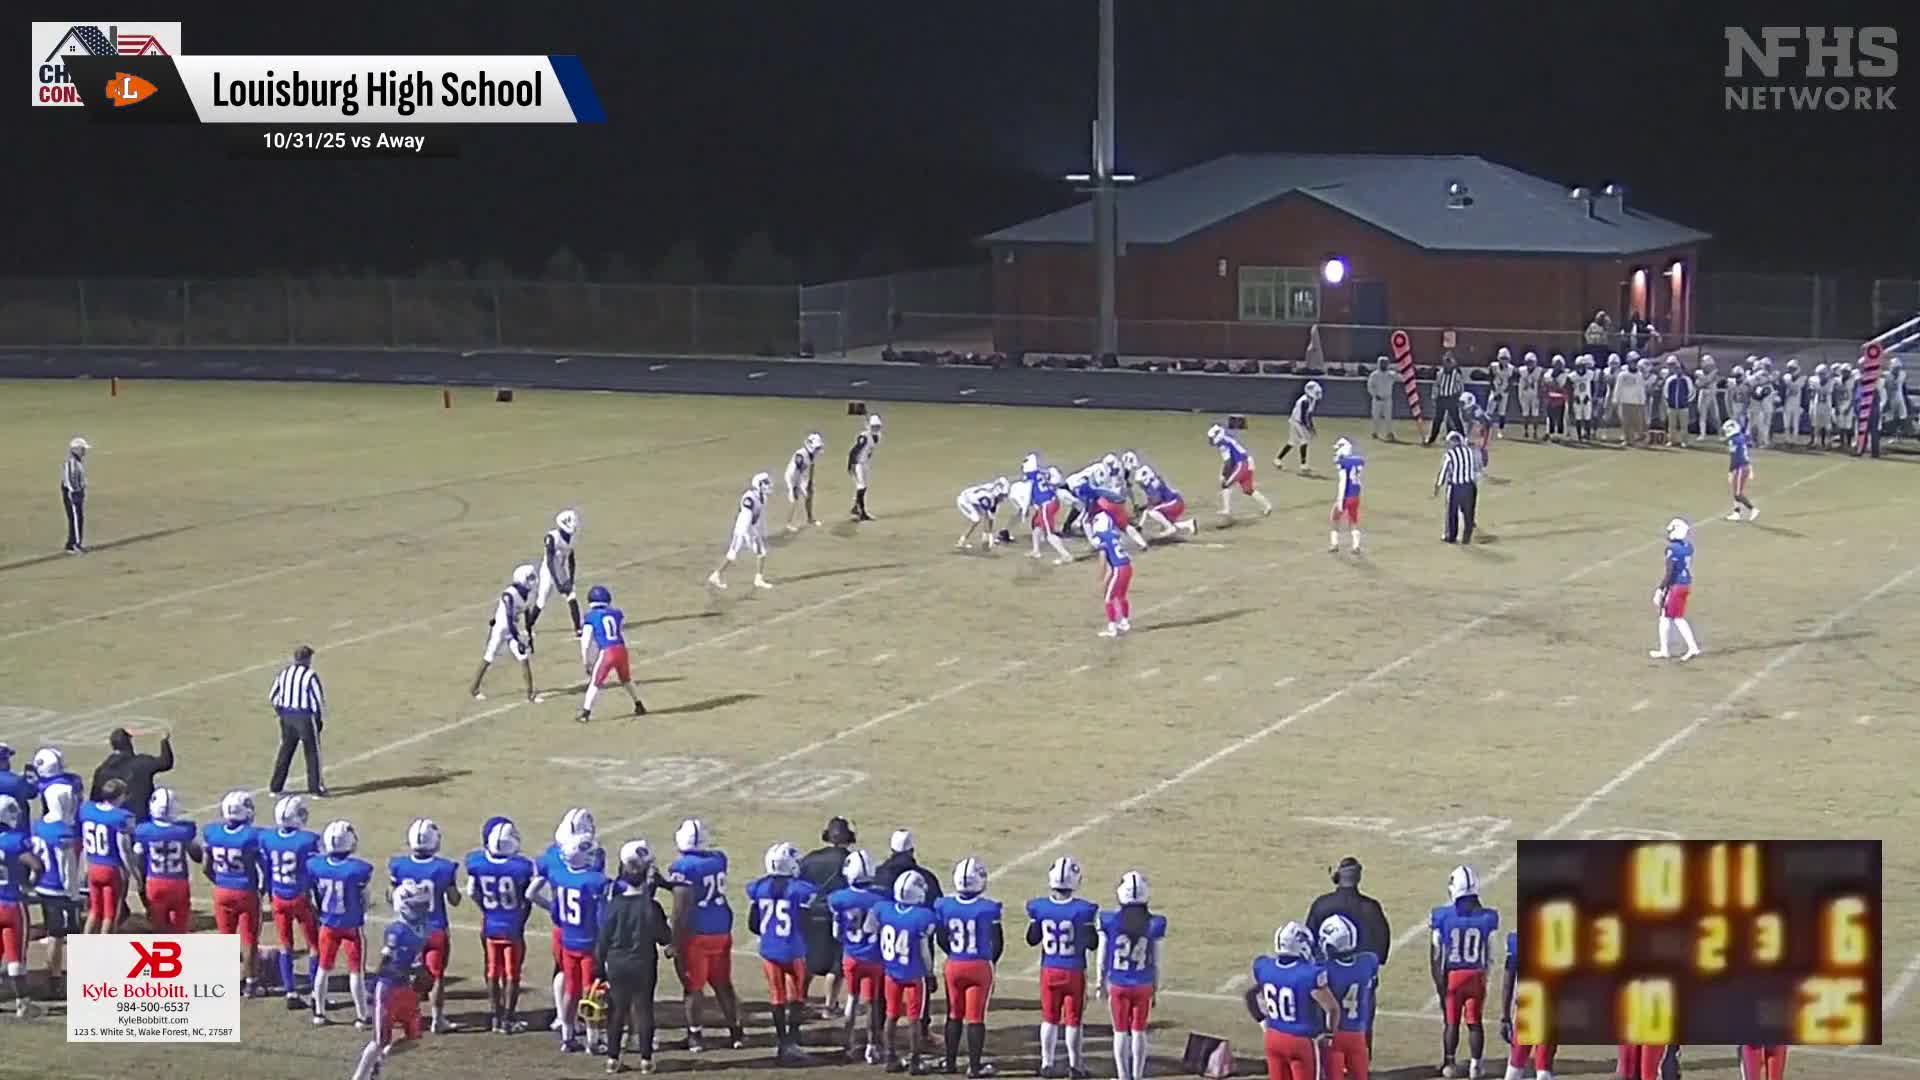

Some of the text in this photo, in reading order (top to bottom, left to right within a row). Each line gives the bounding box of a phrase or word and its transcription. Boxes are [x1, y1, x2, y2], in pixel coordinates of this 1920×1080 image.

[602, 615, 617, 641] 0
[149, 841, 183, 874] 52
[212, 847, 245, 873] 55
[271, 850, 297, 885] 12
[319, 878, 346, 914] 71
[557, 886, 581, 925] 15
[759, 899, 791, 937] 75
[949, 918, 976, 954] 31
[880, 924, 909, 965] 84
[1041, 919, 1075, 956] 62
[1113, 934, 1148, 970] 24
[1449, 927, 1480, 963] 10
[1263, 983, 1296, 1021] 60
